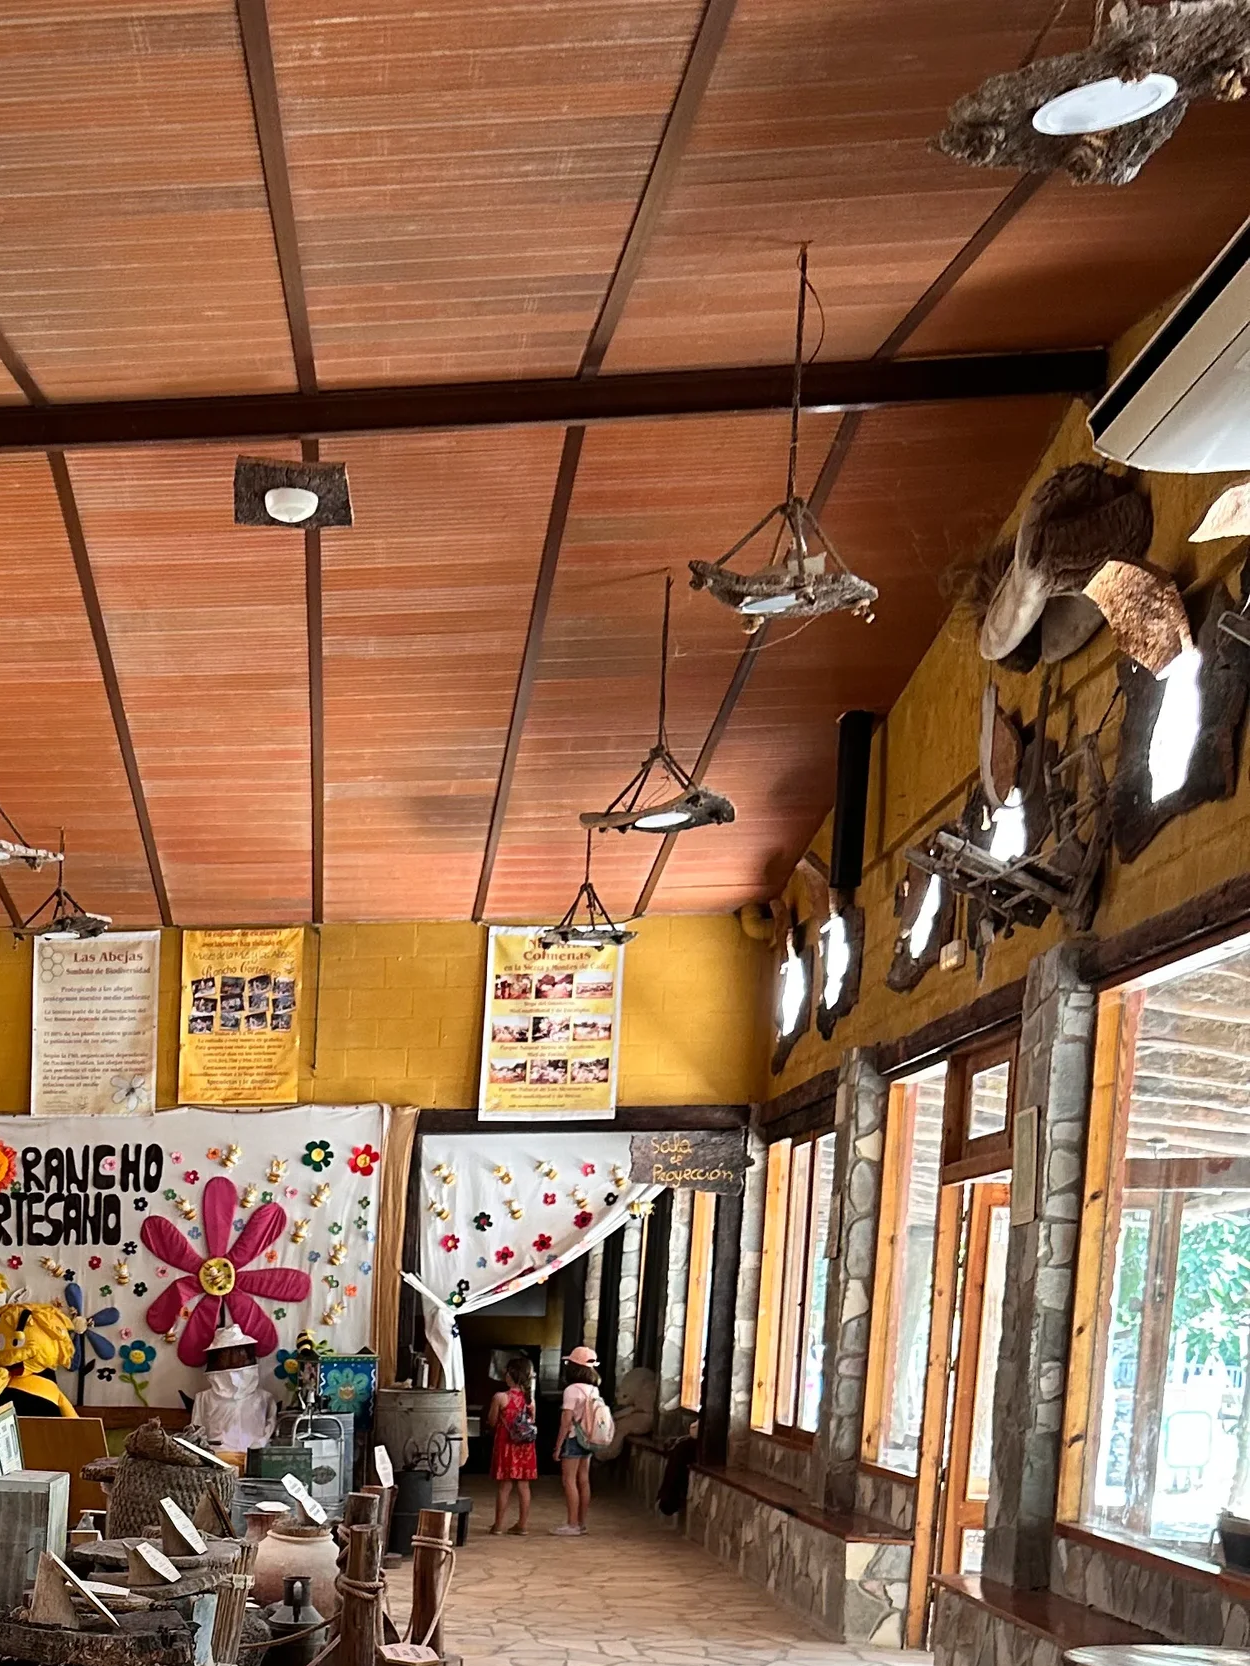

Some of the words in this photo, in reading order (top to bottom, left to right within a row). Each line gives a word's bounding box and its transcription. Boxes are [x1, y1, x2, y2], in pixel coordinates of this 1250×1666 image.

[74, 952, 95, 962] Las
[99, 951, 143, 964] Abejas
[523, 951, 591, 961] Colmenas
[650, 1135, 693, 1154] Sala
[21, 1143, 164, 1193] RANCHO
[670, 1155, 682, 1165] de
[653, 1162, 734, 1188] Proyección
